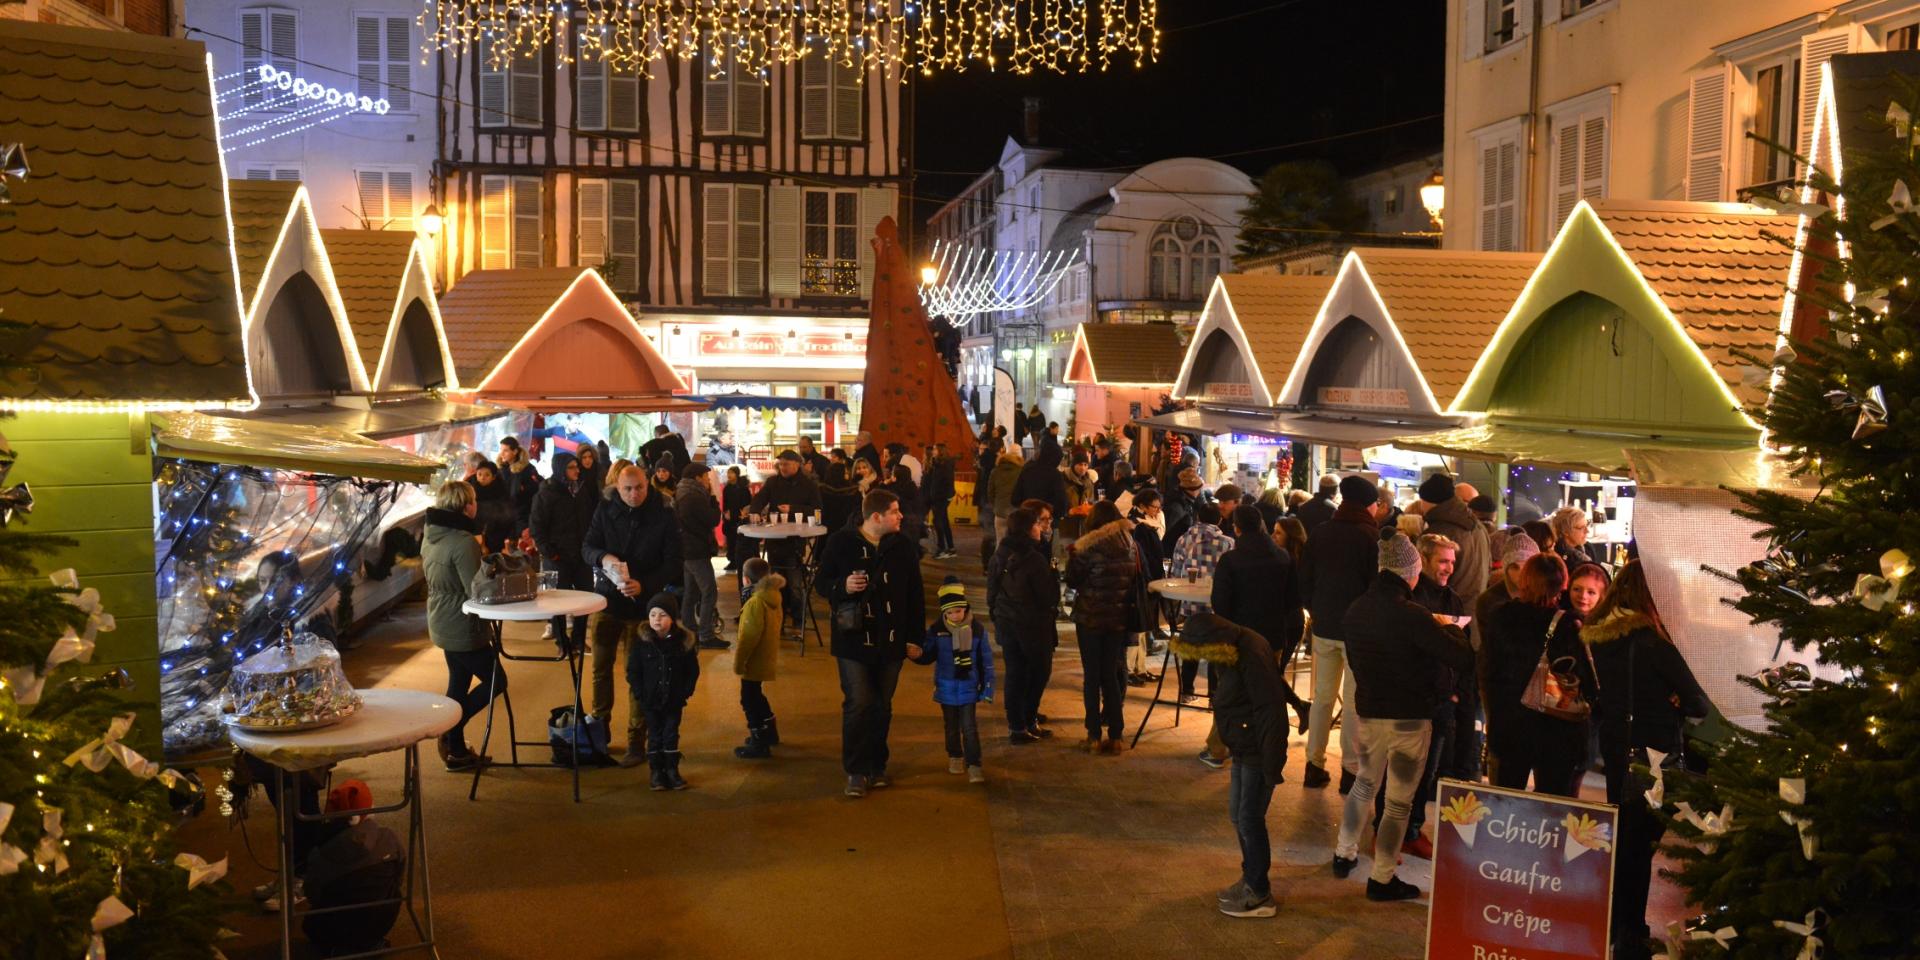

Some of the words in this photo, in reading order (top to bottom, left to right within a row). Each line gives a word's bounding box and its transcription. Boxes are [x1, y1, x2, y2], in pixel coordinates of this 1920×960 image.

[804, 341, 867, 353] Traditio
[1487, 813, 1561, 849] Chichi
[1479, 860, 1562, 895] Gaufre
[1483, 904, 1552, 938] Crêpe
[1472, 944, 1529, 960] Boi
